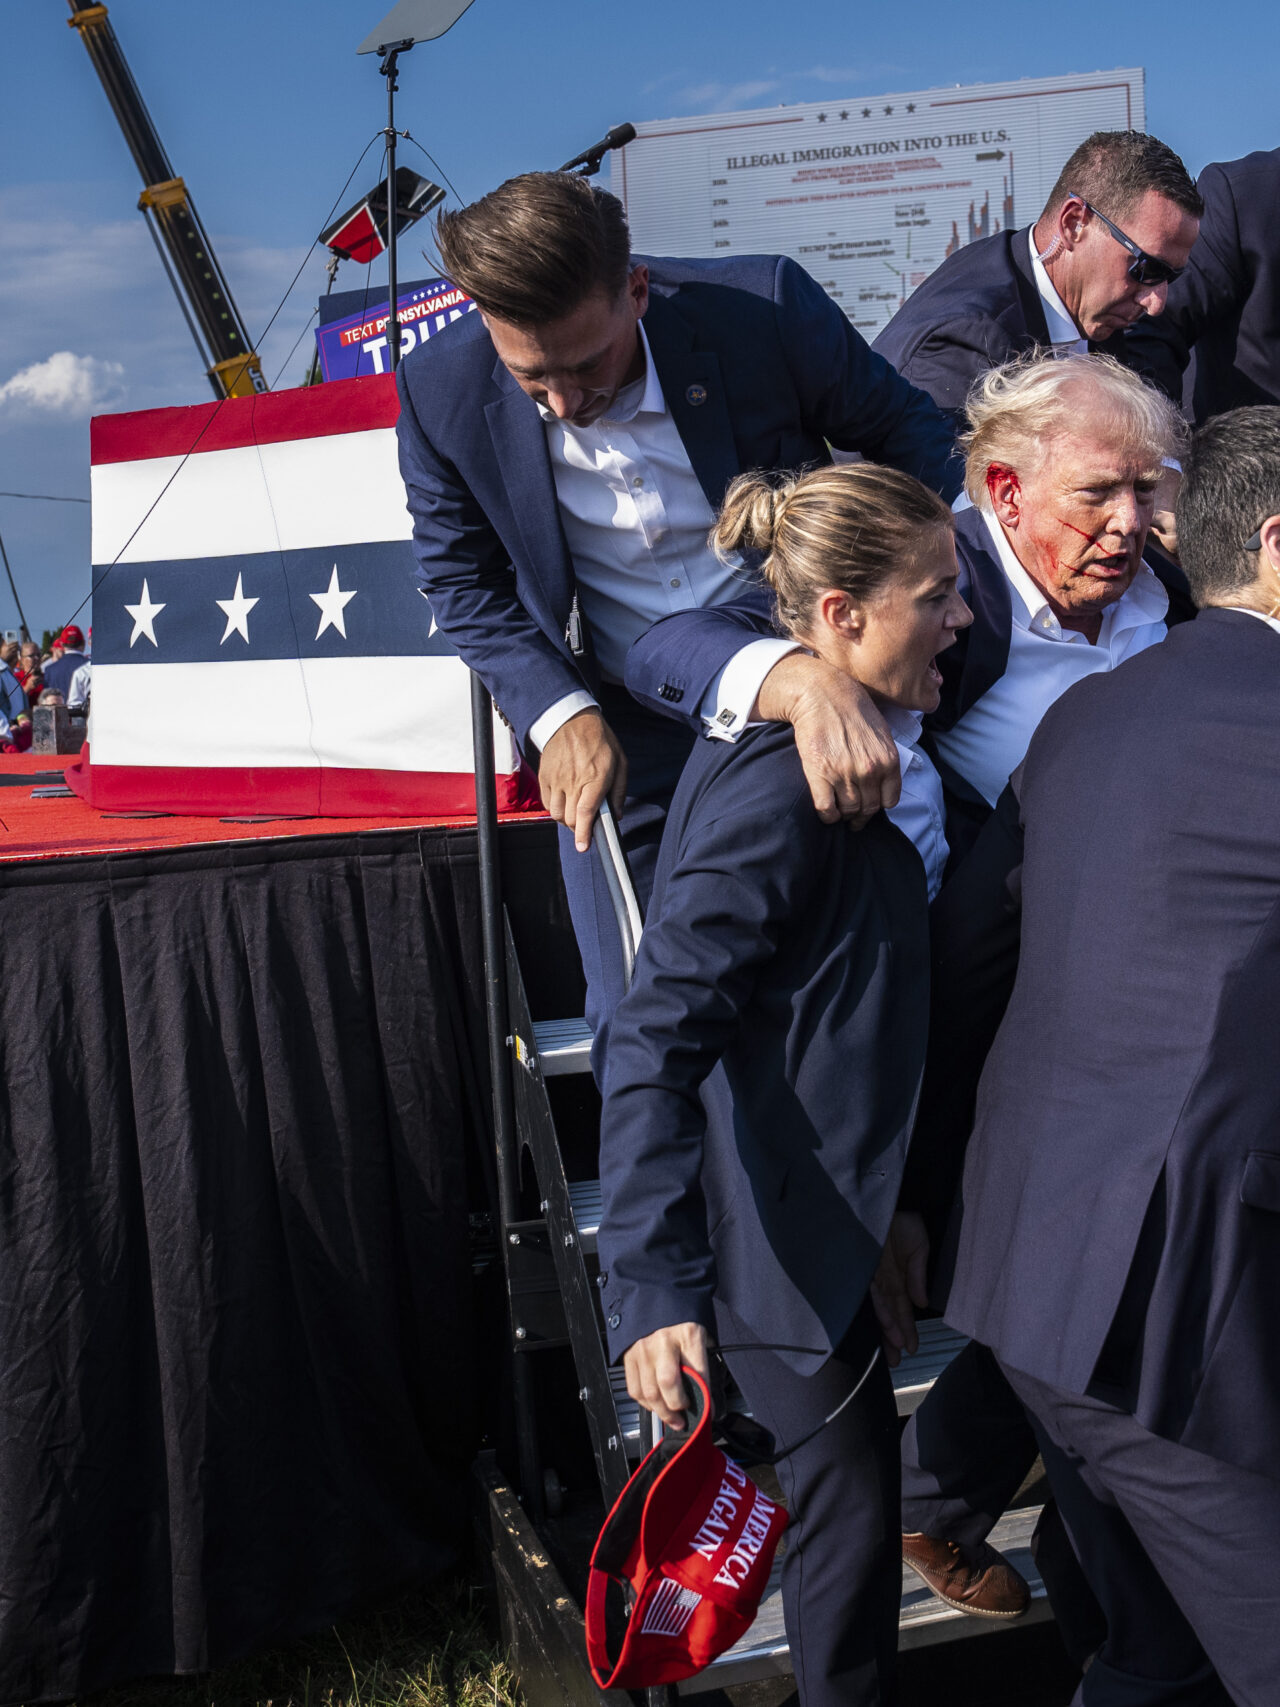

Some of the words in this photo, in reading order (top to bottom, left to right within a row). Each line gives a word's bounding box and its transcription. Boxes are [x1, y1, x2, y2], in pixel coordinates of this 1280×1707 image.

[727, 152, 790, 170] ILLEGAL
[792, 140, 900, 164] IMMIGRATION
[904, 136, 942, 151] INTO
[945, 132, 978, 147] THE
[981, 129, 1012, 144] U.S.
[344, 322, 374, 344] TEXT
[376, 290, 465, 333] PENSYLVANIA
[248, 367, 268, 394] JC
[688, 1478, 742, 1562] AGAIN
